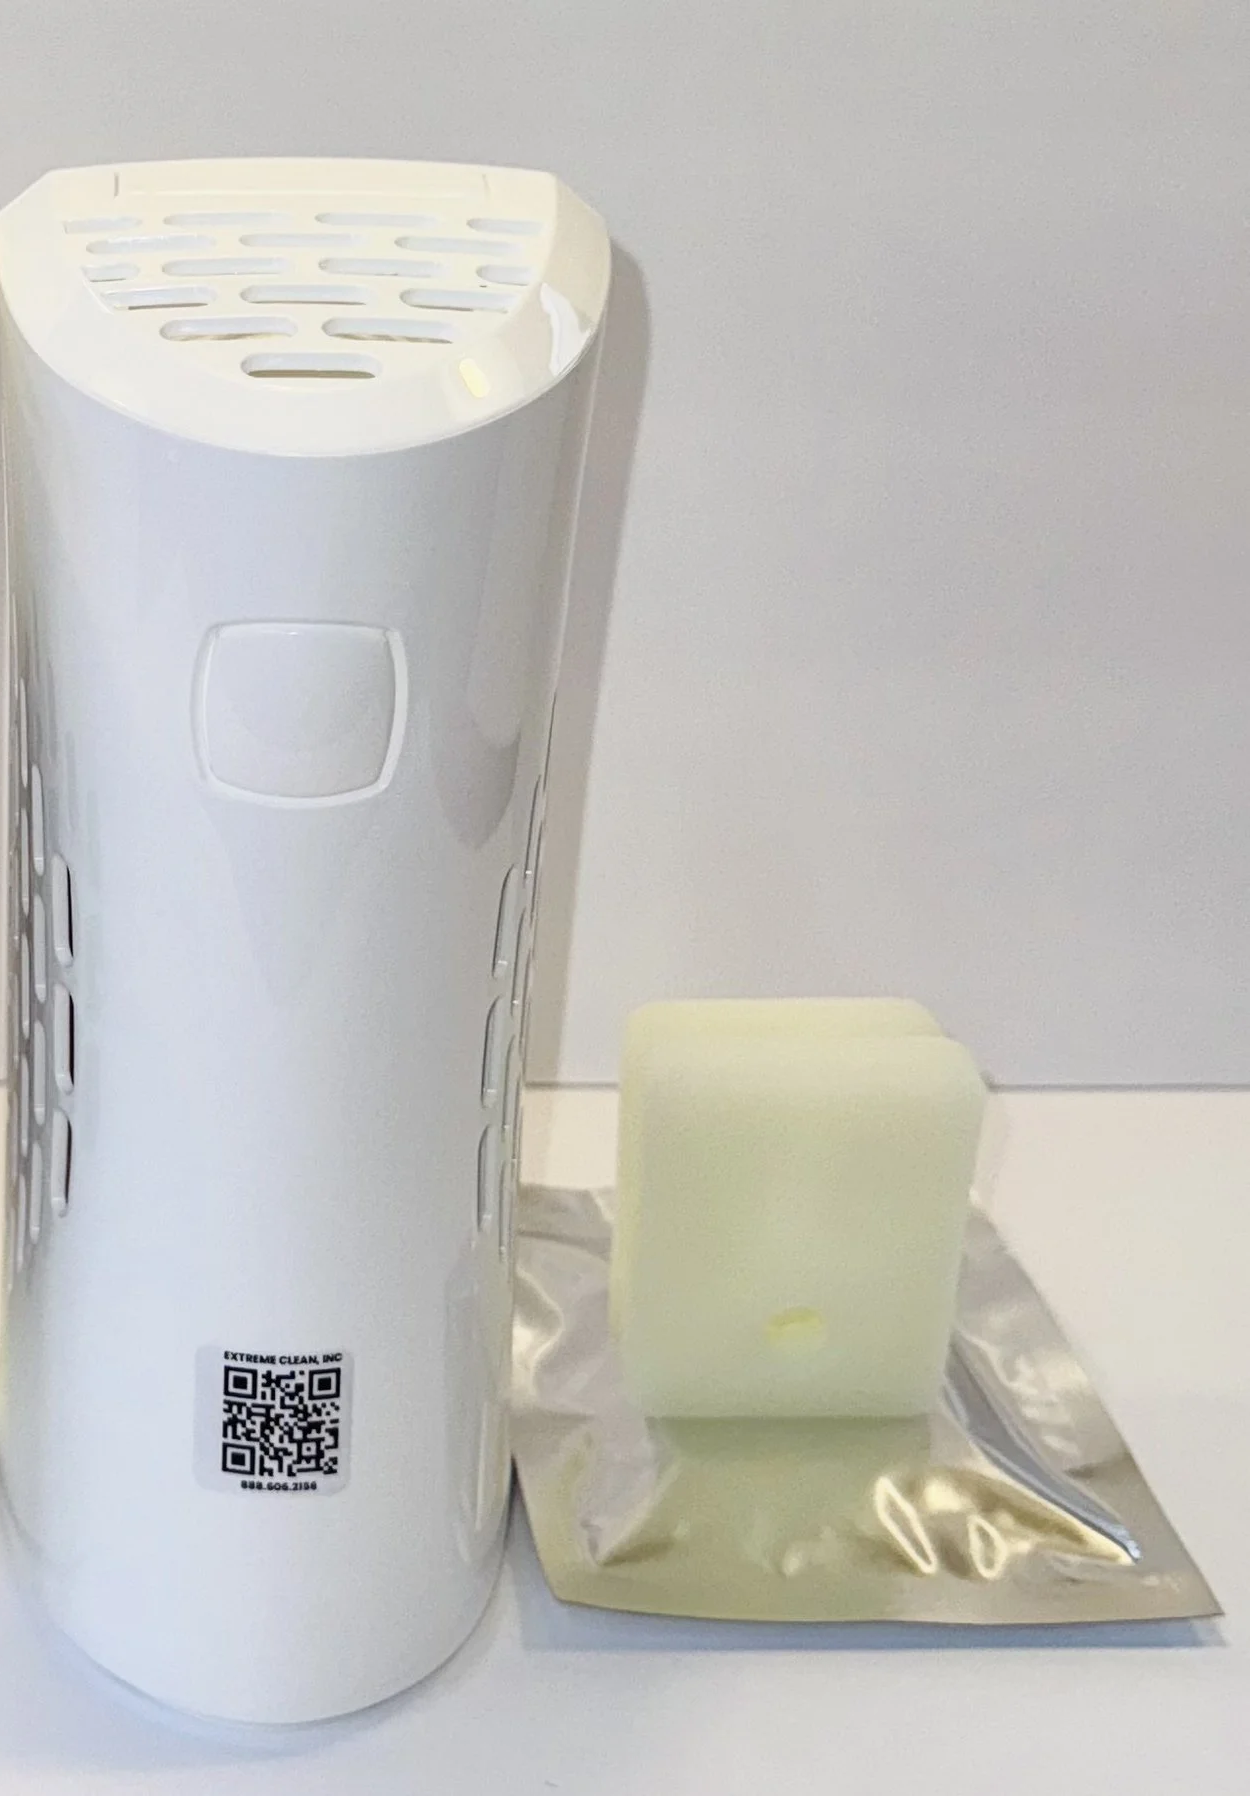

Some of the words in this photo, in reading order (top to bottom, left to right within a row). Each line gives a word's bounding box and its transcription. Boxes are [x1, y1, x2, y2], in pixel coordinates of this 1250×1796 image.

[224, 1351, 276, 1364] EXTREME
[279, 1355, 319, 1365] CLEAN,
[322, 1353, 343, 1363] INC
